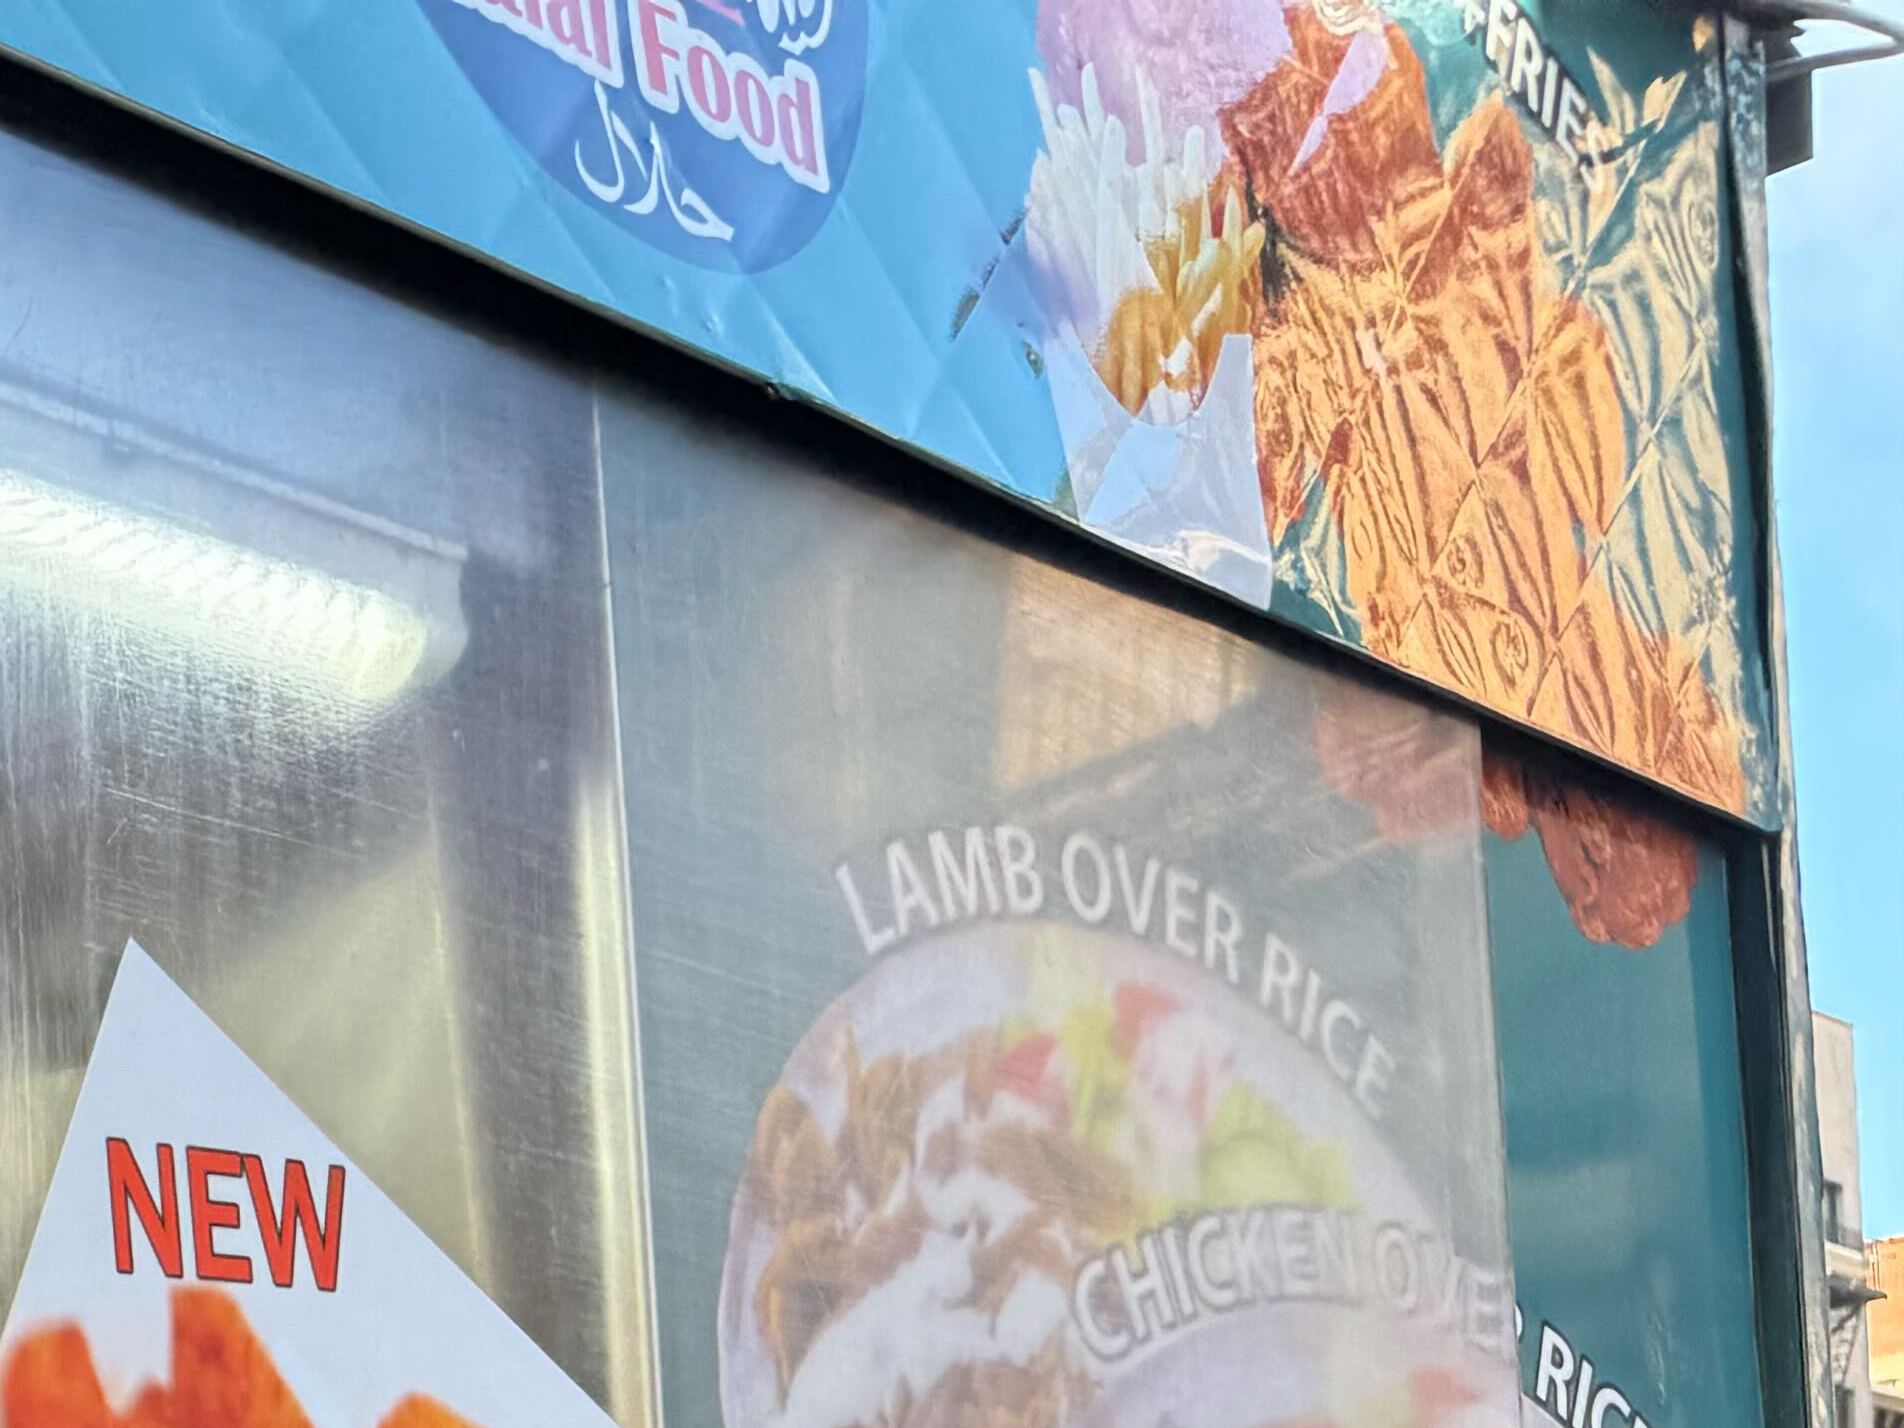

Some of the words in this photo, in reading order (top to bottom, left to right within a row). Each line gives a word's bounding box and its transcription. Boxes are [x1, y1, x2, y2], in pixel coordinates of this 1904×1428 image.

[635, 0, 822, 180] Food
[835, 826, 1043, 955] LAMB
[1060, 830, 1242, 985] OVER
[1261, 931, 1397, 1121] RICE
[105, 1138, 345, 1292] NEW
[1074, 1204, 1360, 1362] CHICKEN
